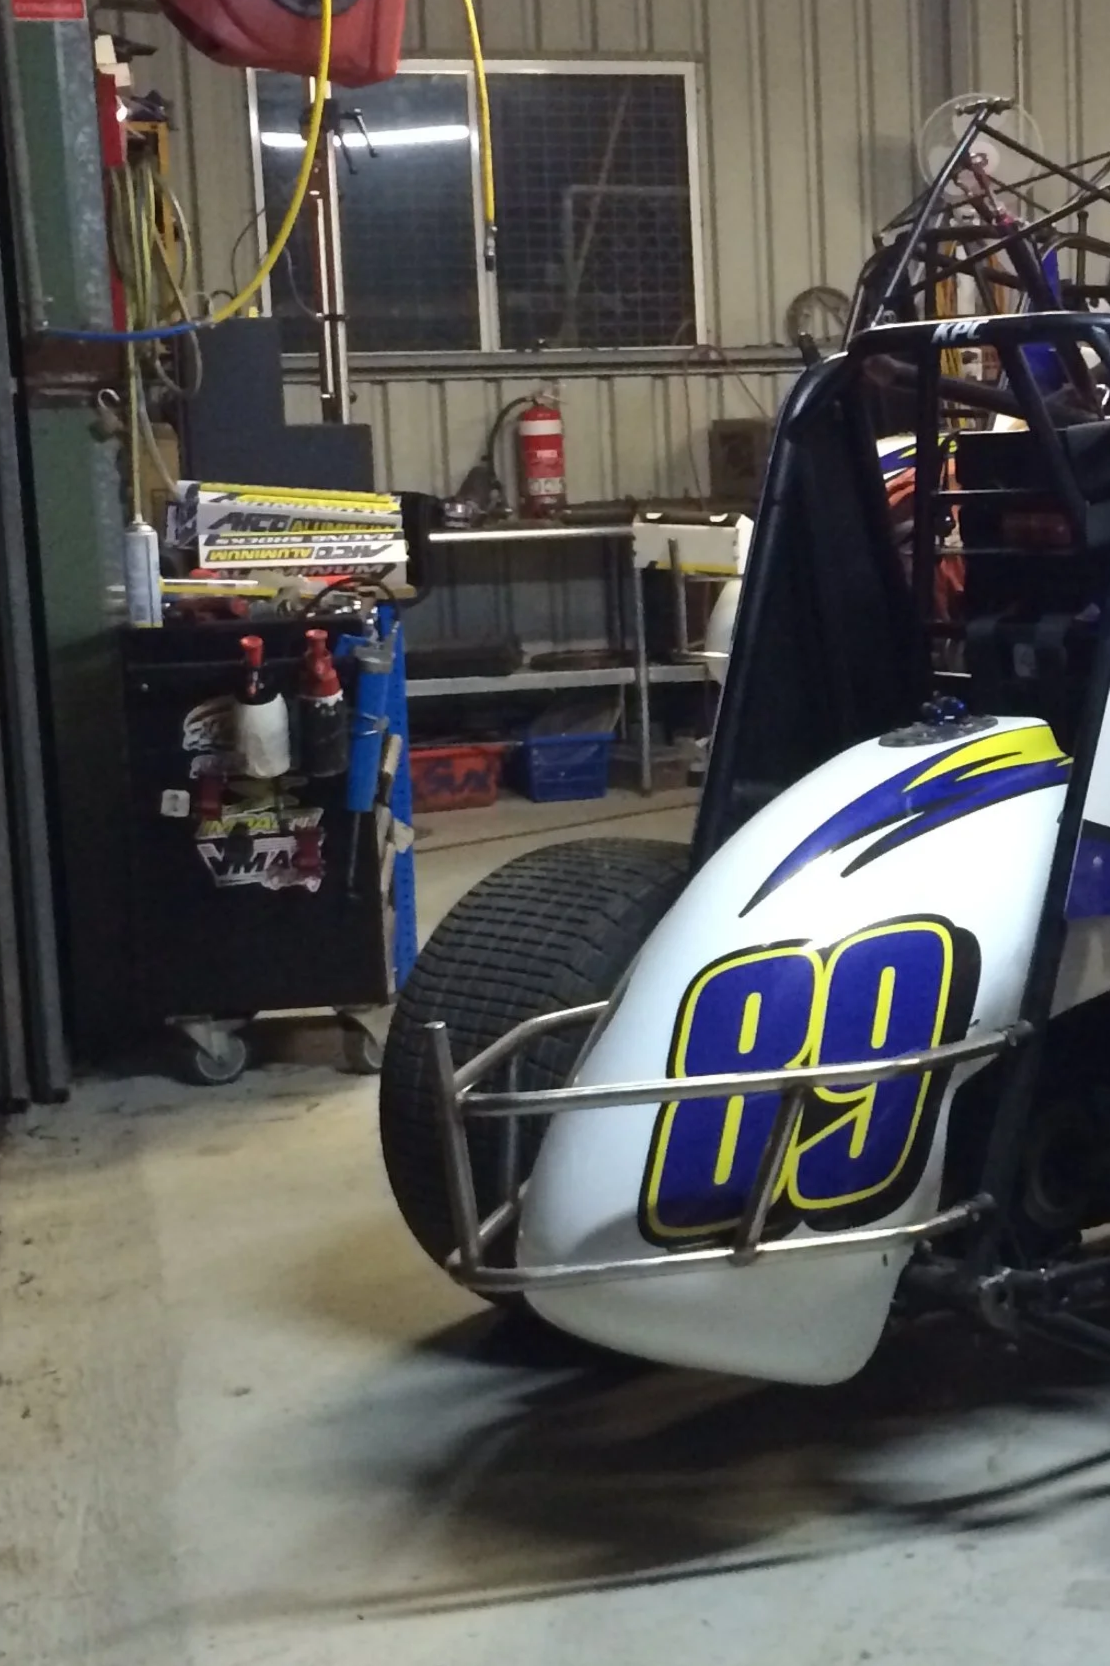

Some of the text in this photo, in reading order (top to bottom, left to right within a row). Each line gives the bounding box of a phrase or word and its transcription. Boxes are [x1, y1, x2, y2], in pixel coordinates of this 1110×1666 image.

[208, 547, 312, 562] ALUMINUM
[217, 562, 384, 580] ALMINUM
[638, 914, 968, 1248] 89
